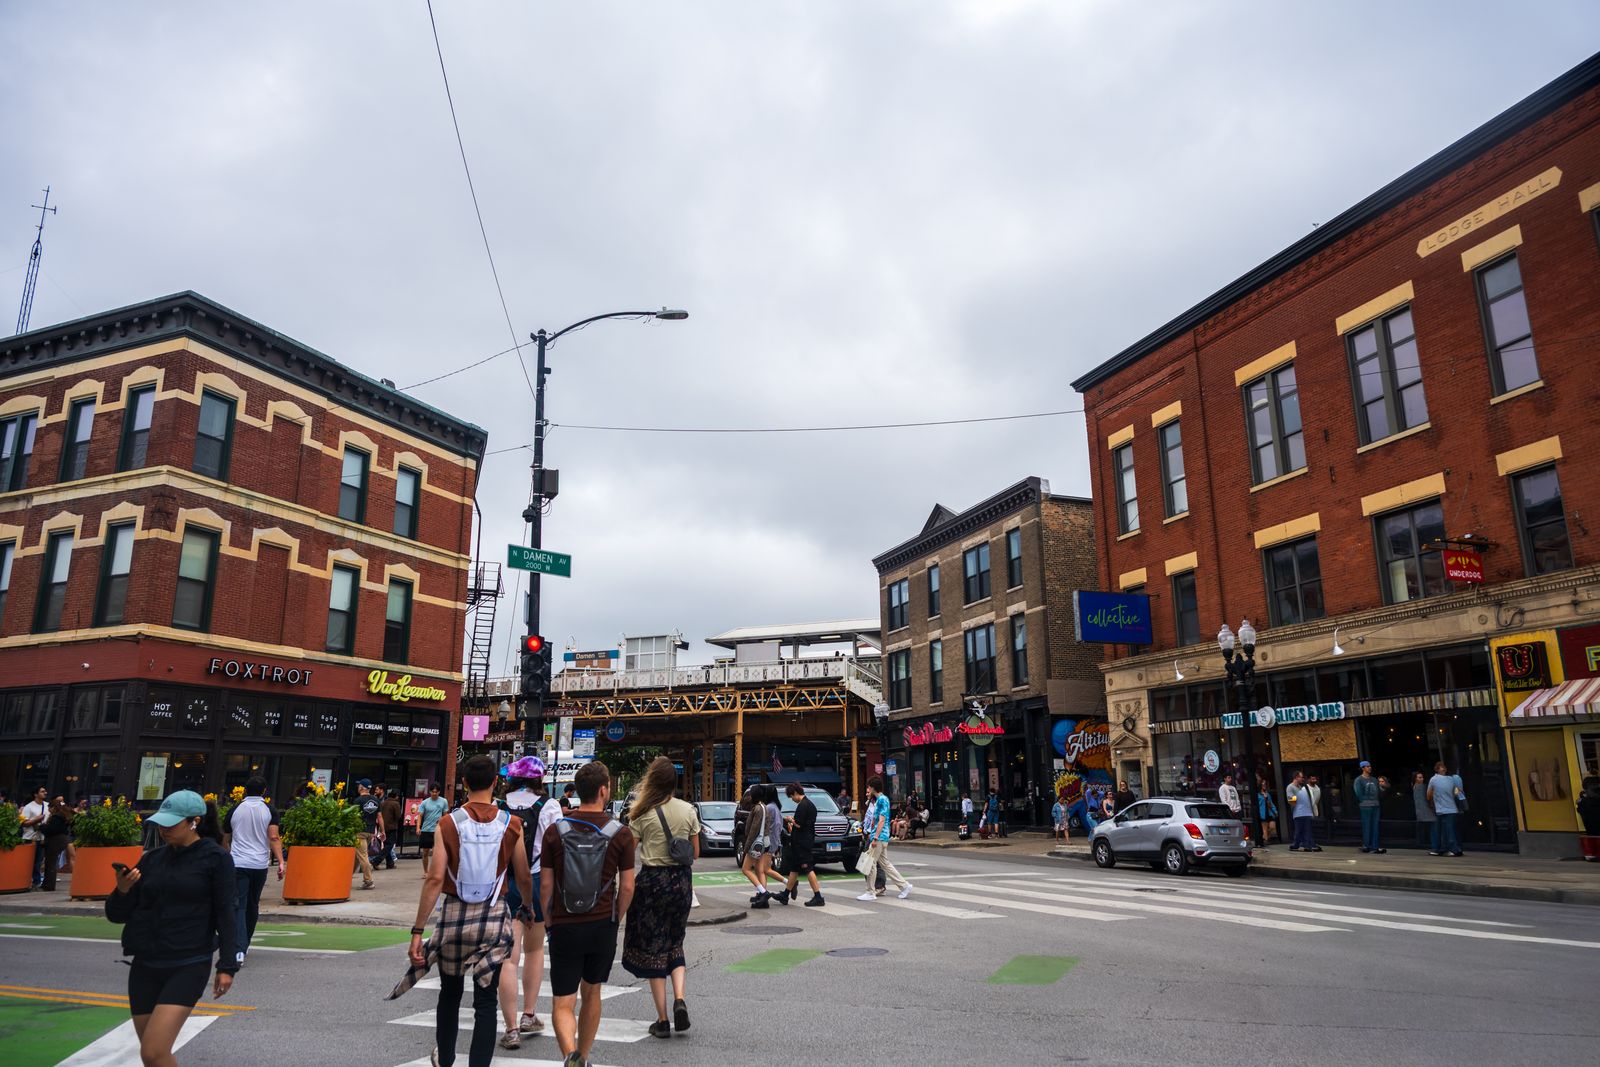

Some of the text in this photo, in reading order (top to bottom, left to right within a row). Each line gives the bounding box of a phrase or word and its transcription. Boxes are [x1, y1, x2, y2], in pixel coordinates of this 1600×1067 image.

[1425, 178, 1551, 250] LODGE HALL
[523, 550, 553, 564] DAMEN
[525, 561, 542, 570] 2000
[1449, 569, 1482, 580] UNDERDOG
[1087, 603, 1141, 630] collective
[1501, 644, 1534, 678] U
[209, 658, 313, 685] FOXTROT
[367, 669, 447, 702] Van Leeuwen
[153, 703, 172, 711] HOT
[236, 705, 250, 717] ICED
[320, 714, 338, 723] GOOD
[1275, 706, 1308, 724] SLICES
[1316, 702, 1345, 721] SUDS
[231, 712, 251, 728] COFFEE
[319, 723, 337, 731] TIMES
[355, 722, 383, 731] ICE CREAM
[387, 725, 410, 733] SUNDAES
[411, 727, 440, 735] MILKSHAKES
[608, 727, 624, 735] cta
